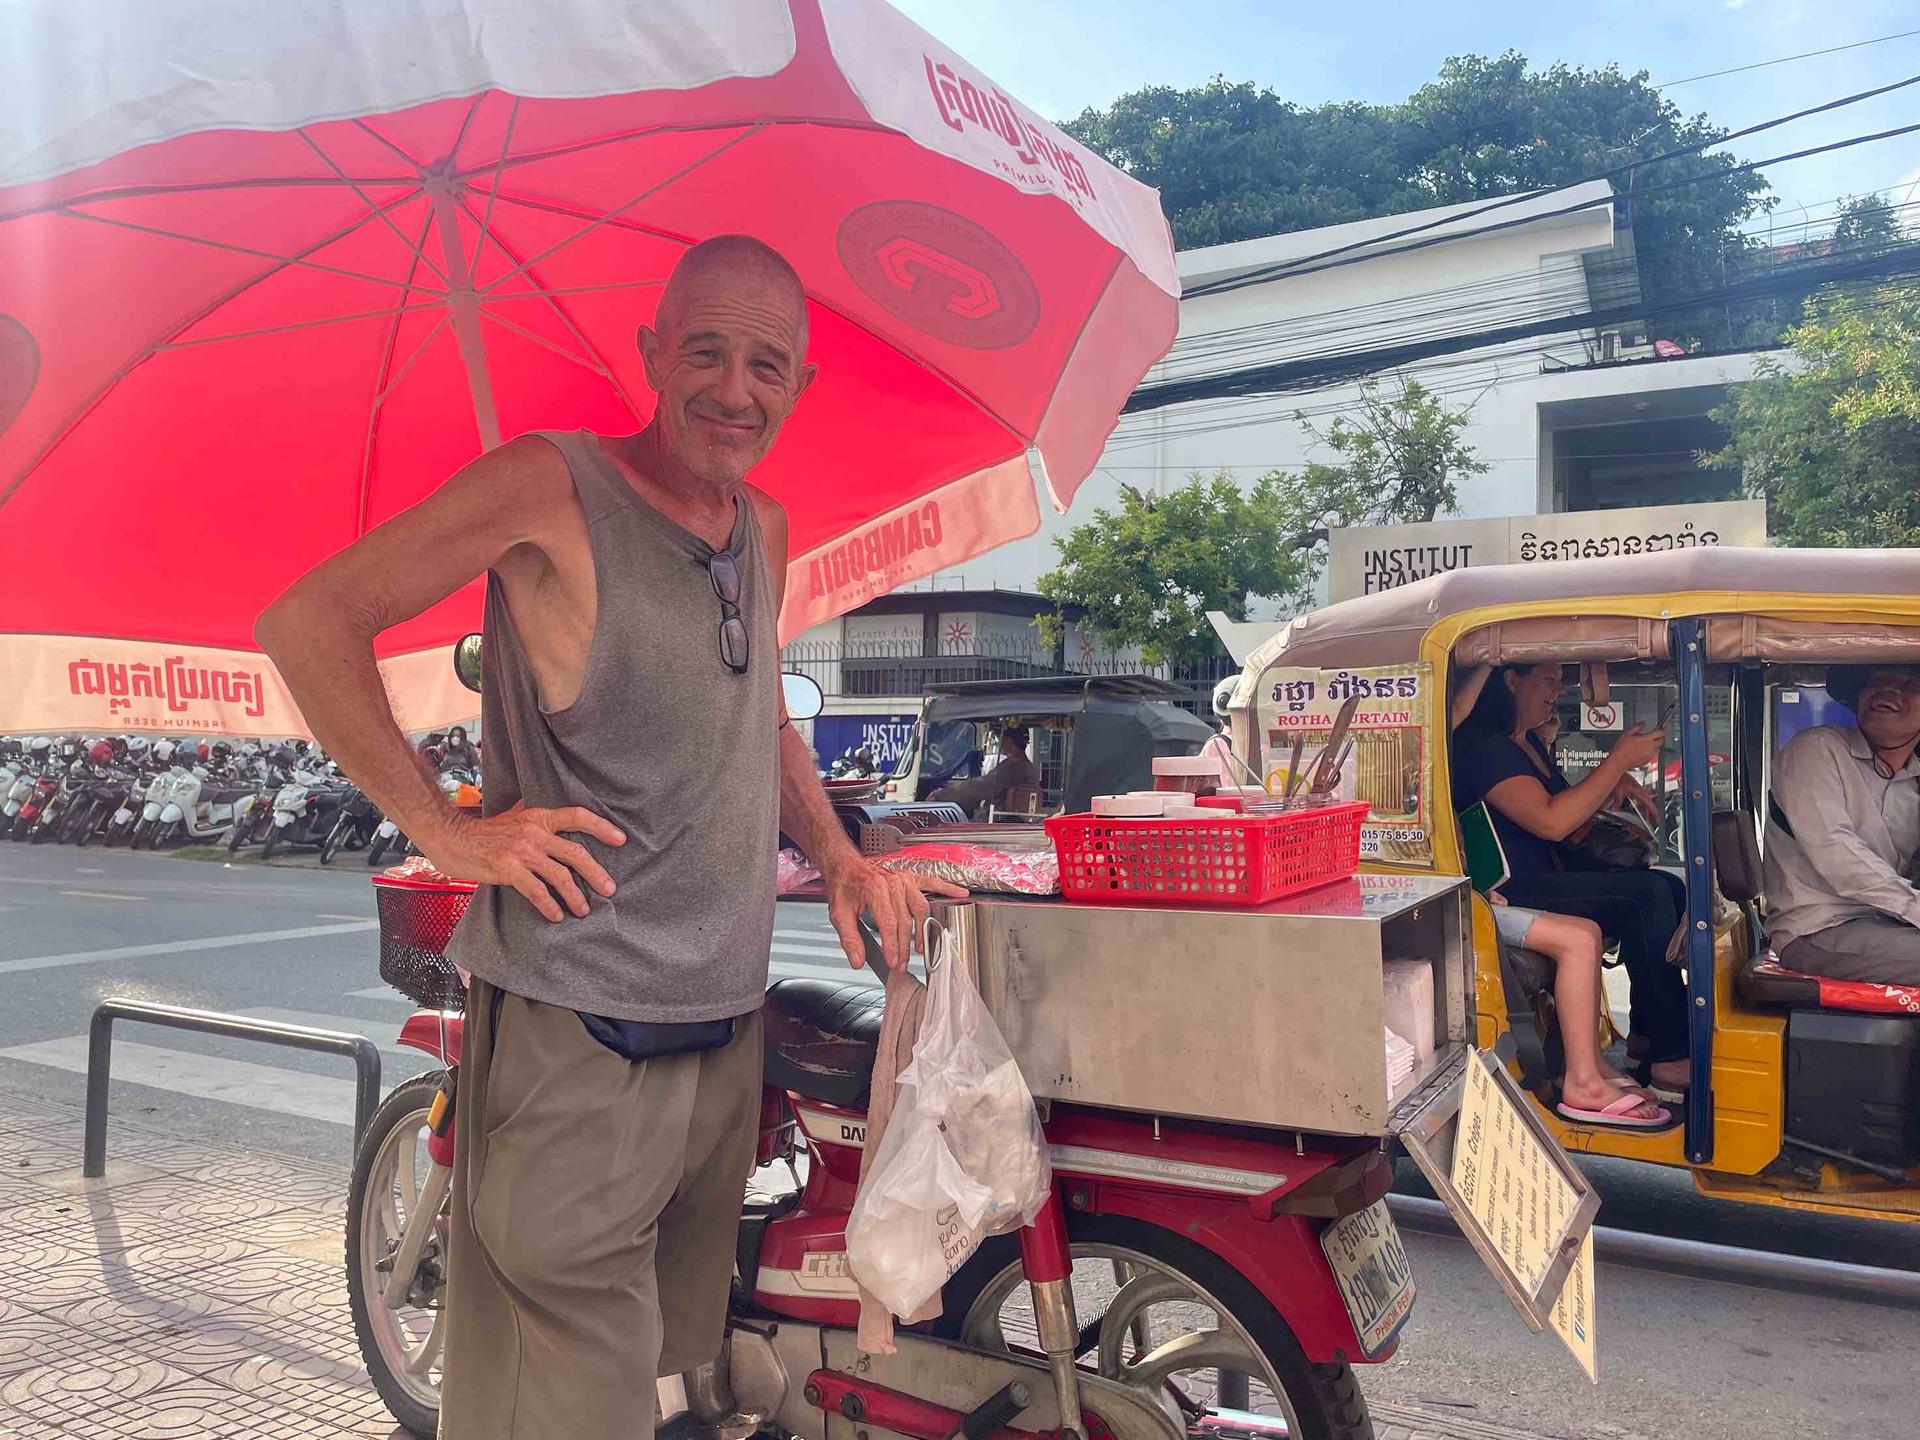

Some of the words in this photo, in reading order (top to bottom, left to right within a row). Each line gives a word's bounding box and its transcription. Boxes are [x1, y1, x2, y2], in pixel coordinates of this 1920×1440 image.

[1364, 545, 1473, 575] INSTITUT
[1364, 568, 1443, 596] FRAN
[1278, 714, 1333, 727] ROTHA
[1350, 711, 1411, 725] URTAIN
[862, 723, 916, 745] INSTIT
[1361, 829, 1378, 839] 015
[1380, 830, 1393, 840] 75
[1395, 831, 1408, 841] 85
[1410, 831, 1423, 841] 30
[1361, 843, 1378, 852] 320
[1375, 1307, 1399, 1340] PHNOM
